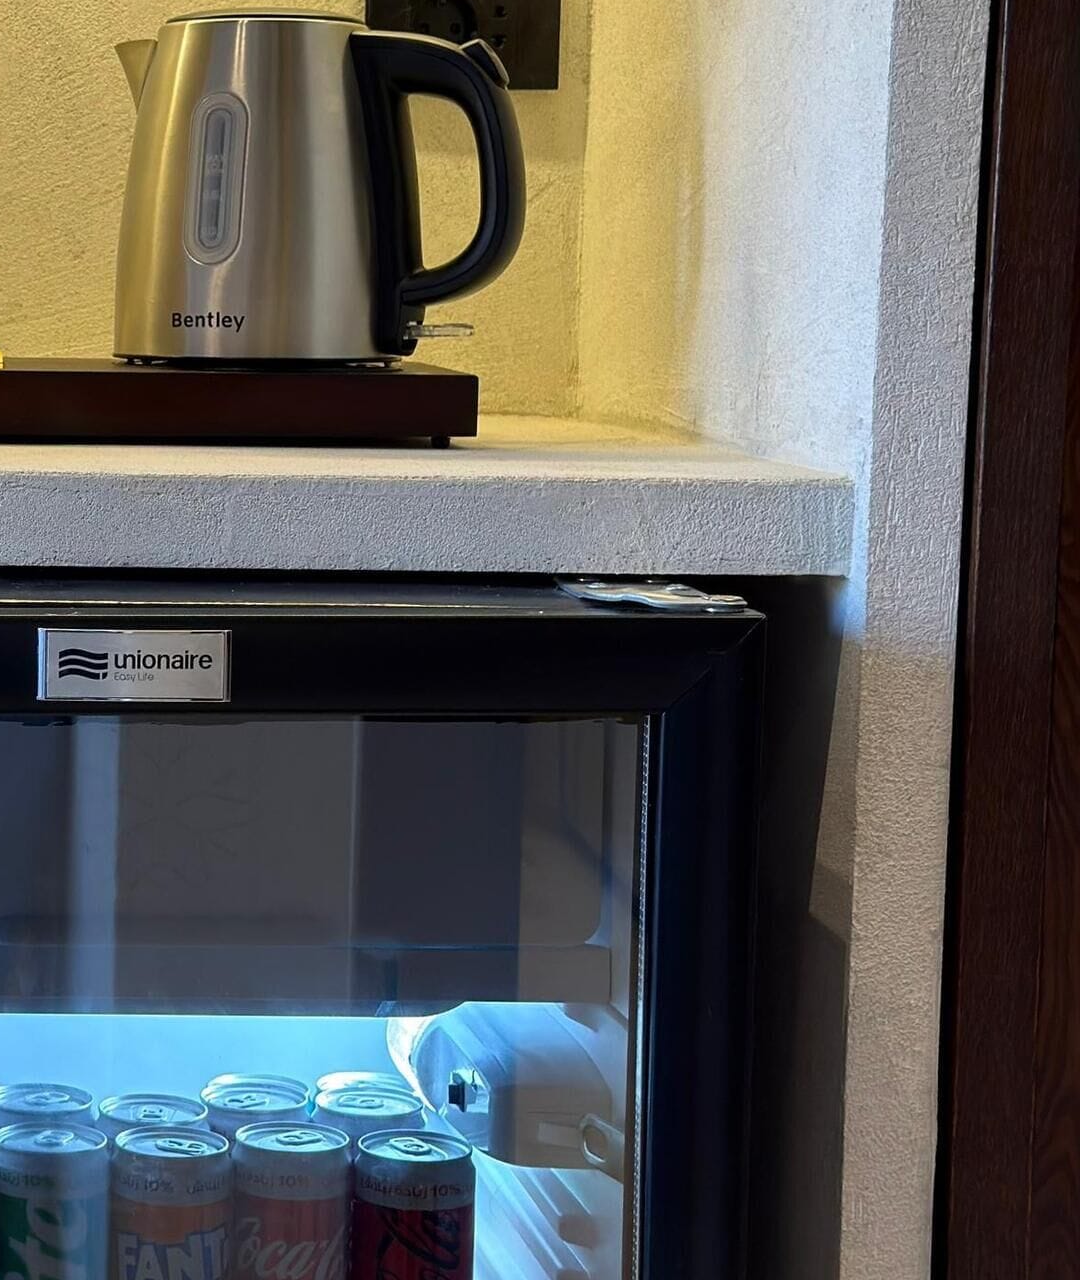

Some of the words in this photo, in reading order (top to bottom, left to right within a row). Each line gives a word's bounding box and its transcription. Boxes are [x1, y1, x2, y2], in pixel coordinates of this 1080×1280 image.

[172, 312, 245, 333] Bentley
[114, 650, 213, 670] unionaire
[114, 672, 135, 682] Easy
